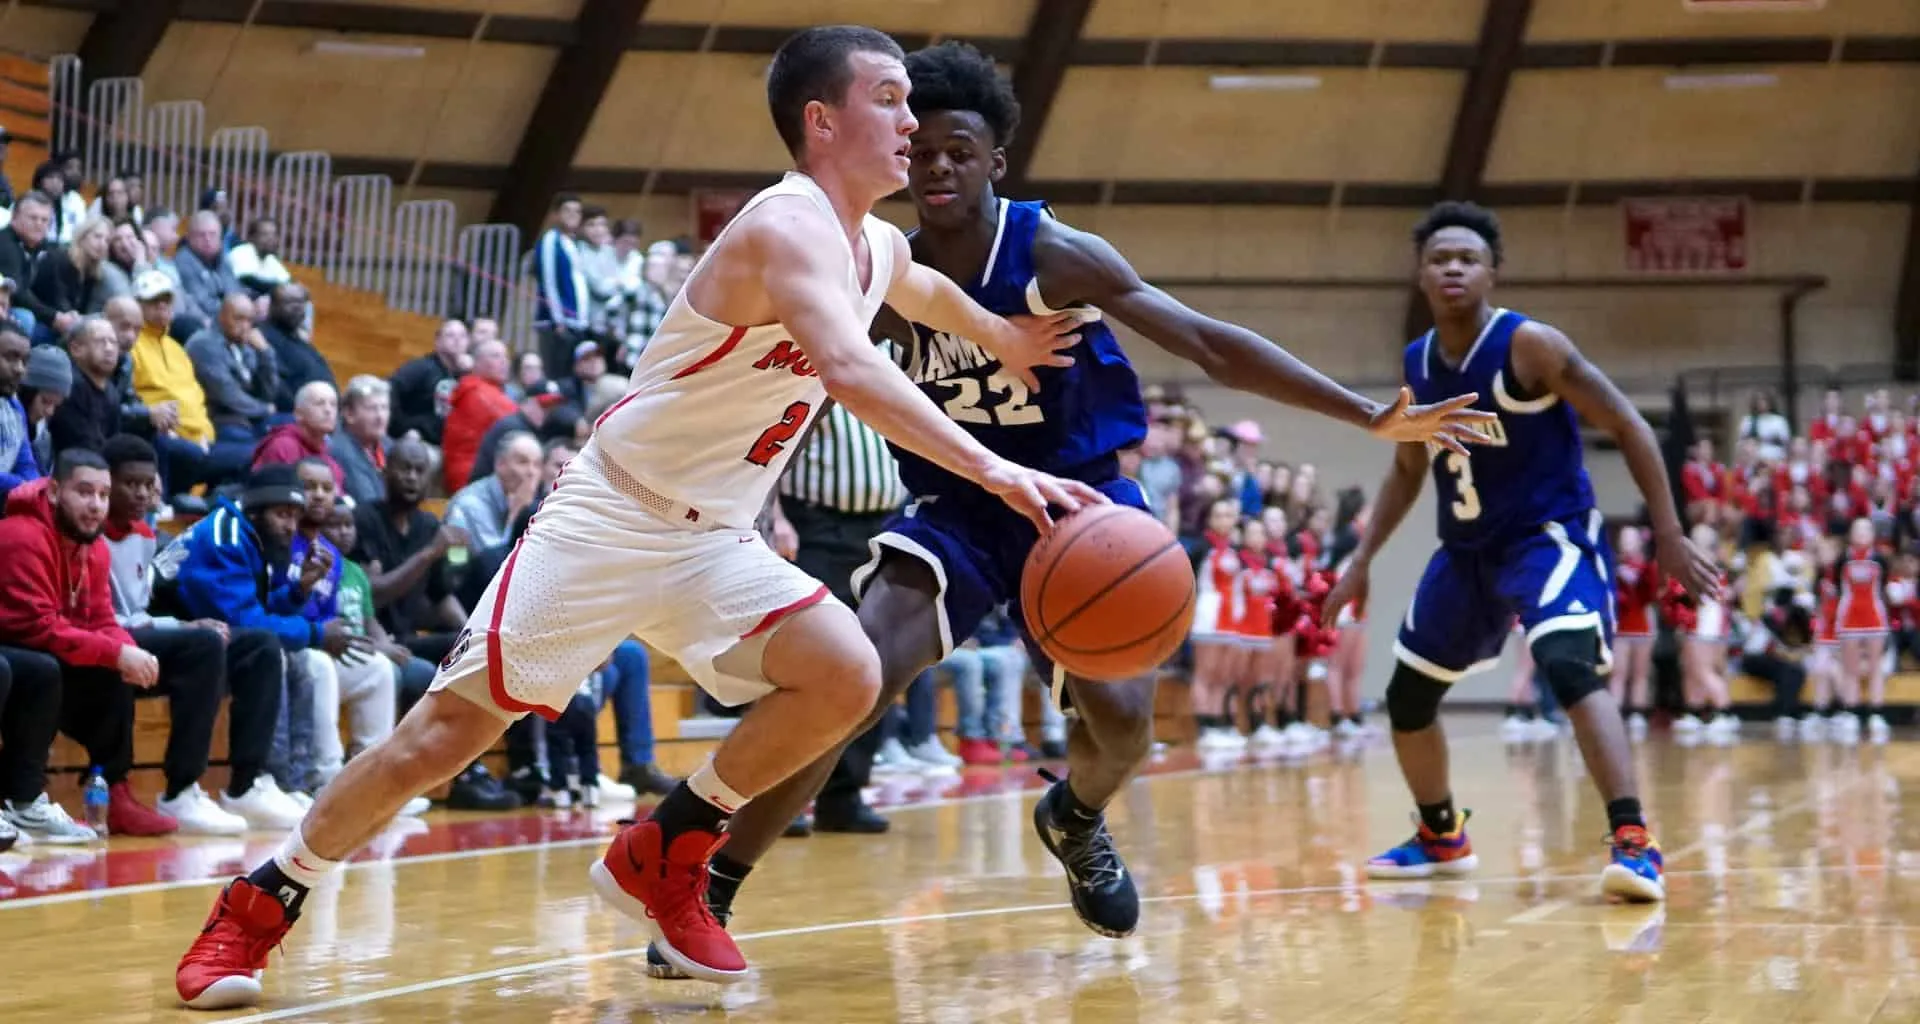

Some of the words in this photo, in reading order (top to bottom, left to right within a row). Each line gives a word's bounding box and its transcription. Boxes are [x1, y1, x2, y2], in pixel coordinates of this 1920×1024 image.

[936, 372, 1045, 426] 22
[744, 400, 810, 467] 2
[1447, 452, 1482, 520] 3
